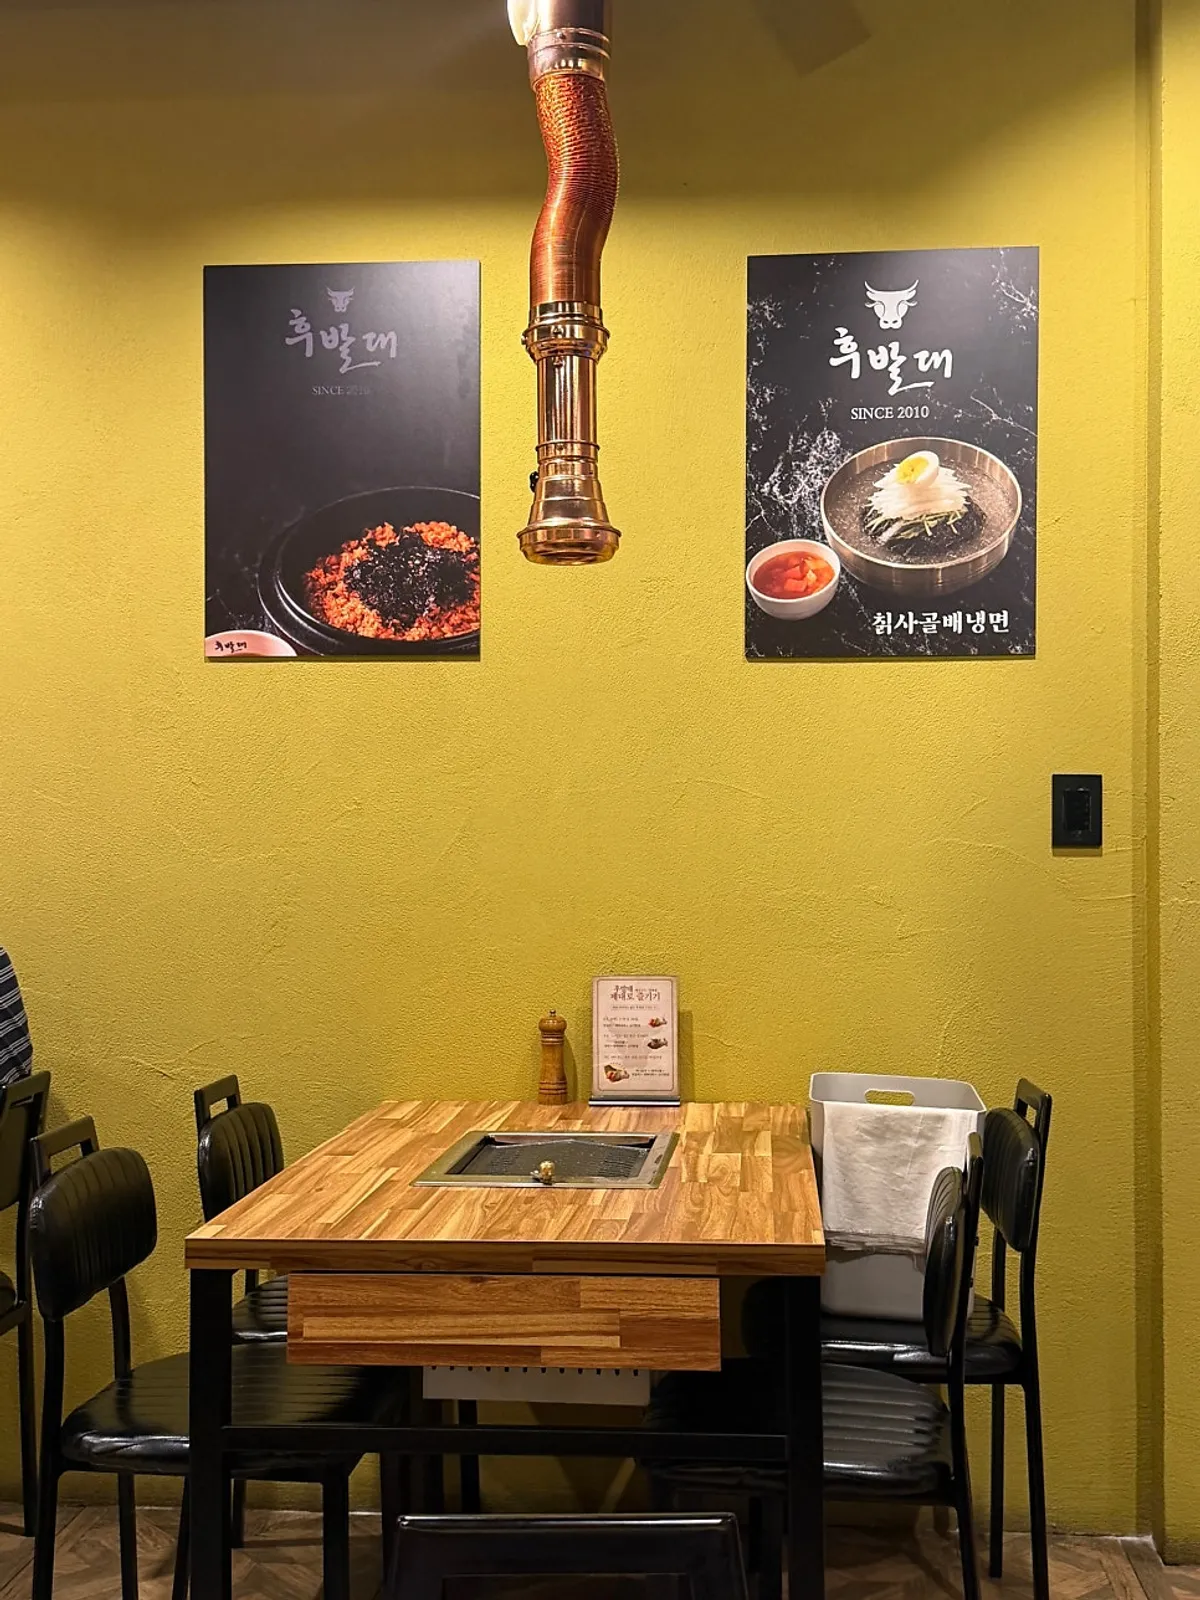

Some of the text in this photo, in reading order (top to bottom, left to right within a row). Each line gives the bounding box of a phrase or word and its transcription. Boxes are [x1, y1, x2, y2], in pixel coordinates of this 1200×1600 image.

[285, 309, 398, 374] 후발대
[829, 327, 953, 396] 후발대
[312, 386, 344, 395] SINCE
[850, 405, 931, 420] SINCE 2010
[872, 609, 1010, 635] 칡사골배냉면
[214, 641, 248, 654] 후발대
